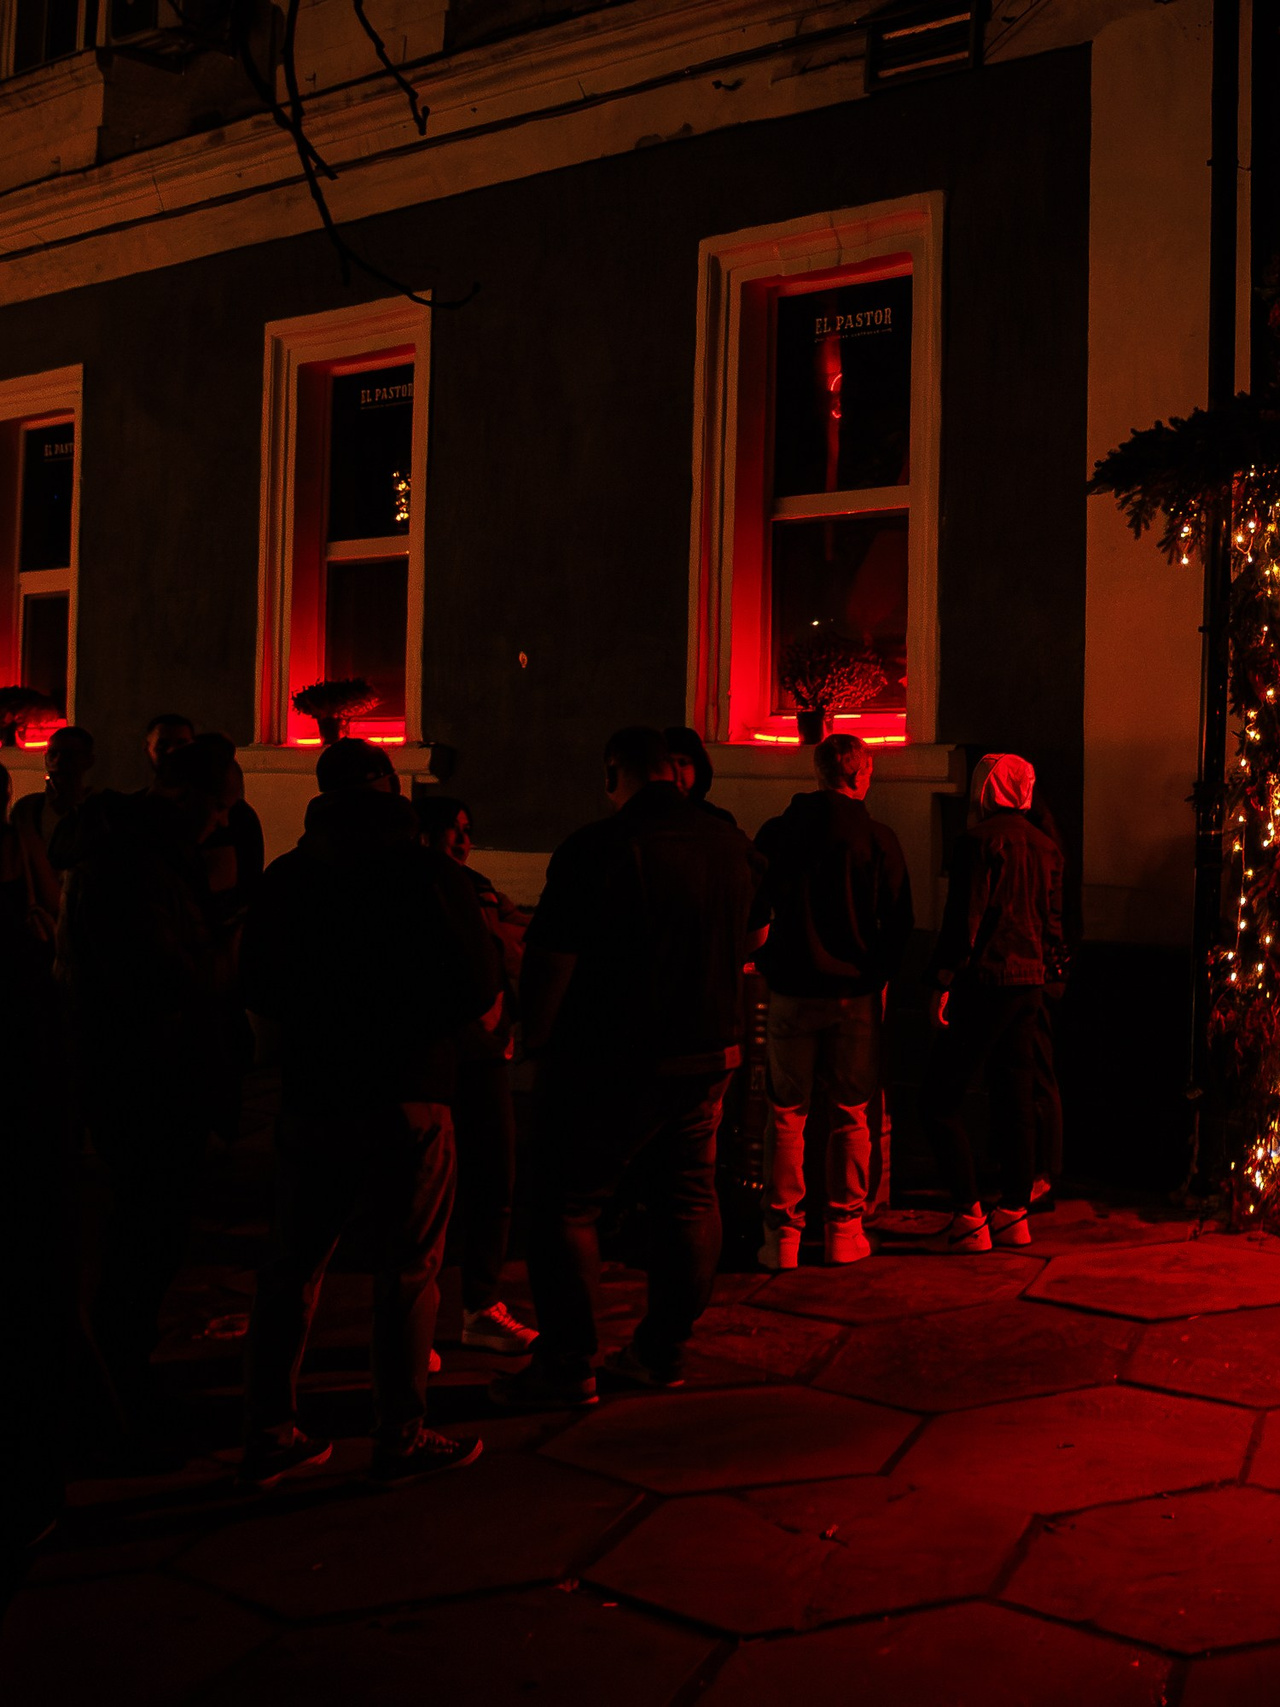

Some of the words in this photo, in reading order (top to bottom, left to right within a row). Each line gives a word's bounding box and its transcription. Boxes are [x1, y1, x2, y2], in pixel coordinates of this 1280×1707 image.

[815, 317, 832, 335] EL
[835, 307, 892, 331] PASTOR
[361, 389, 372, 404] EL
